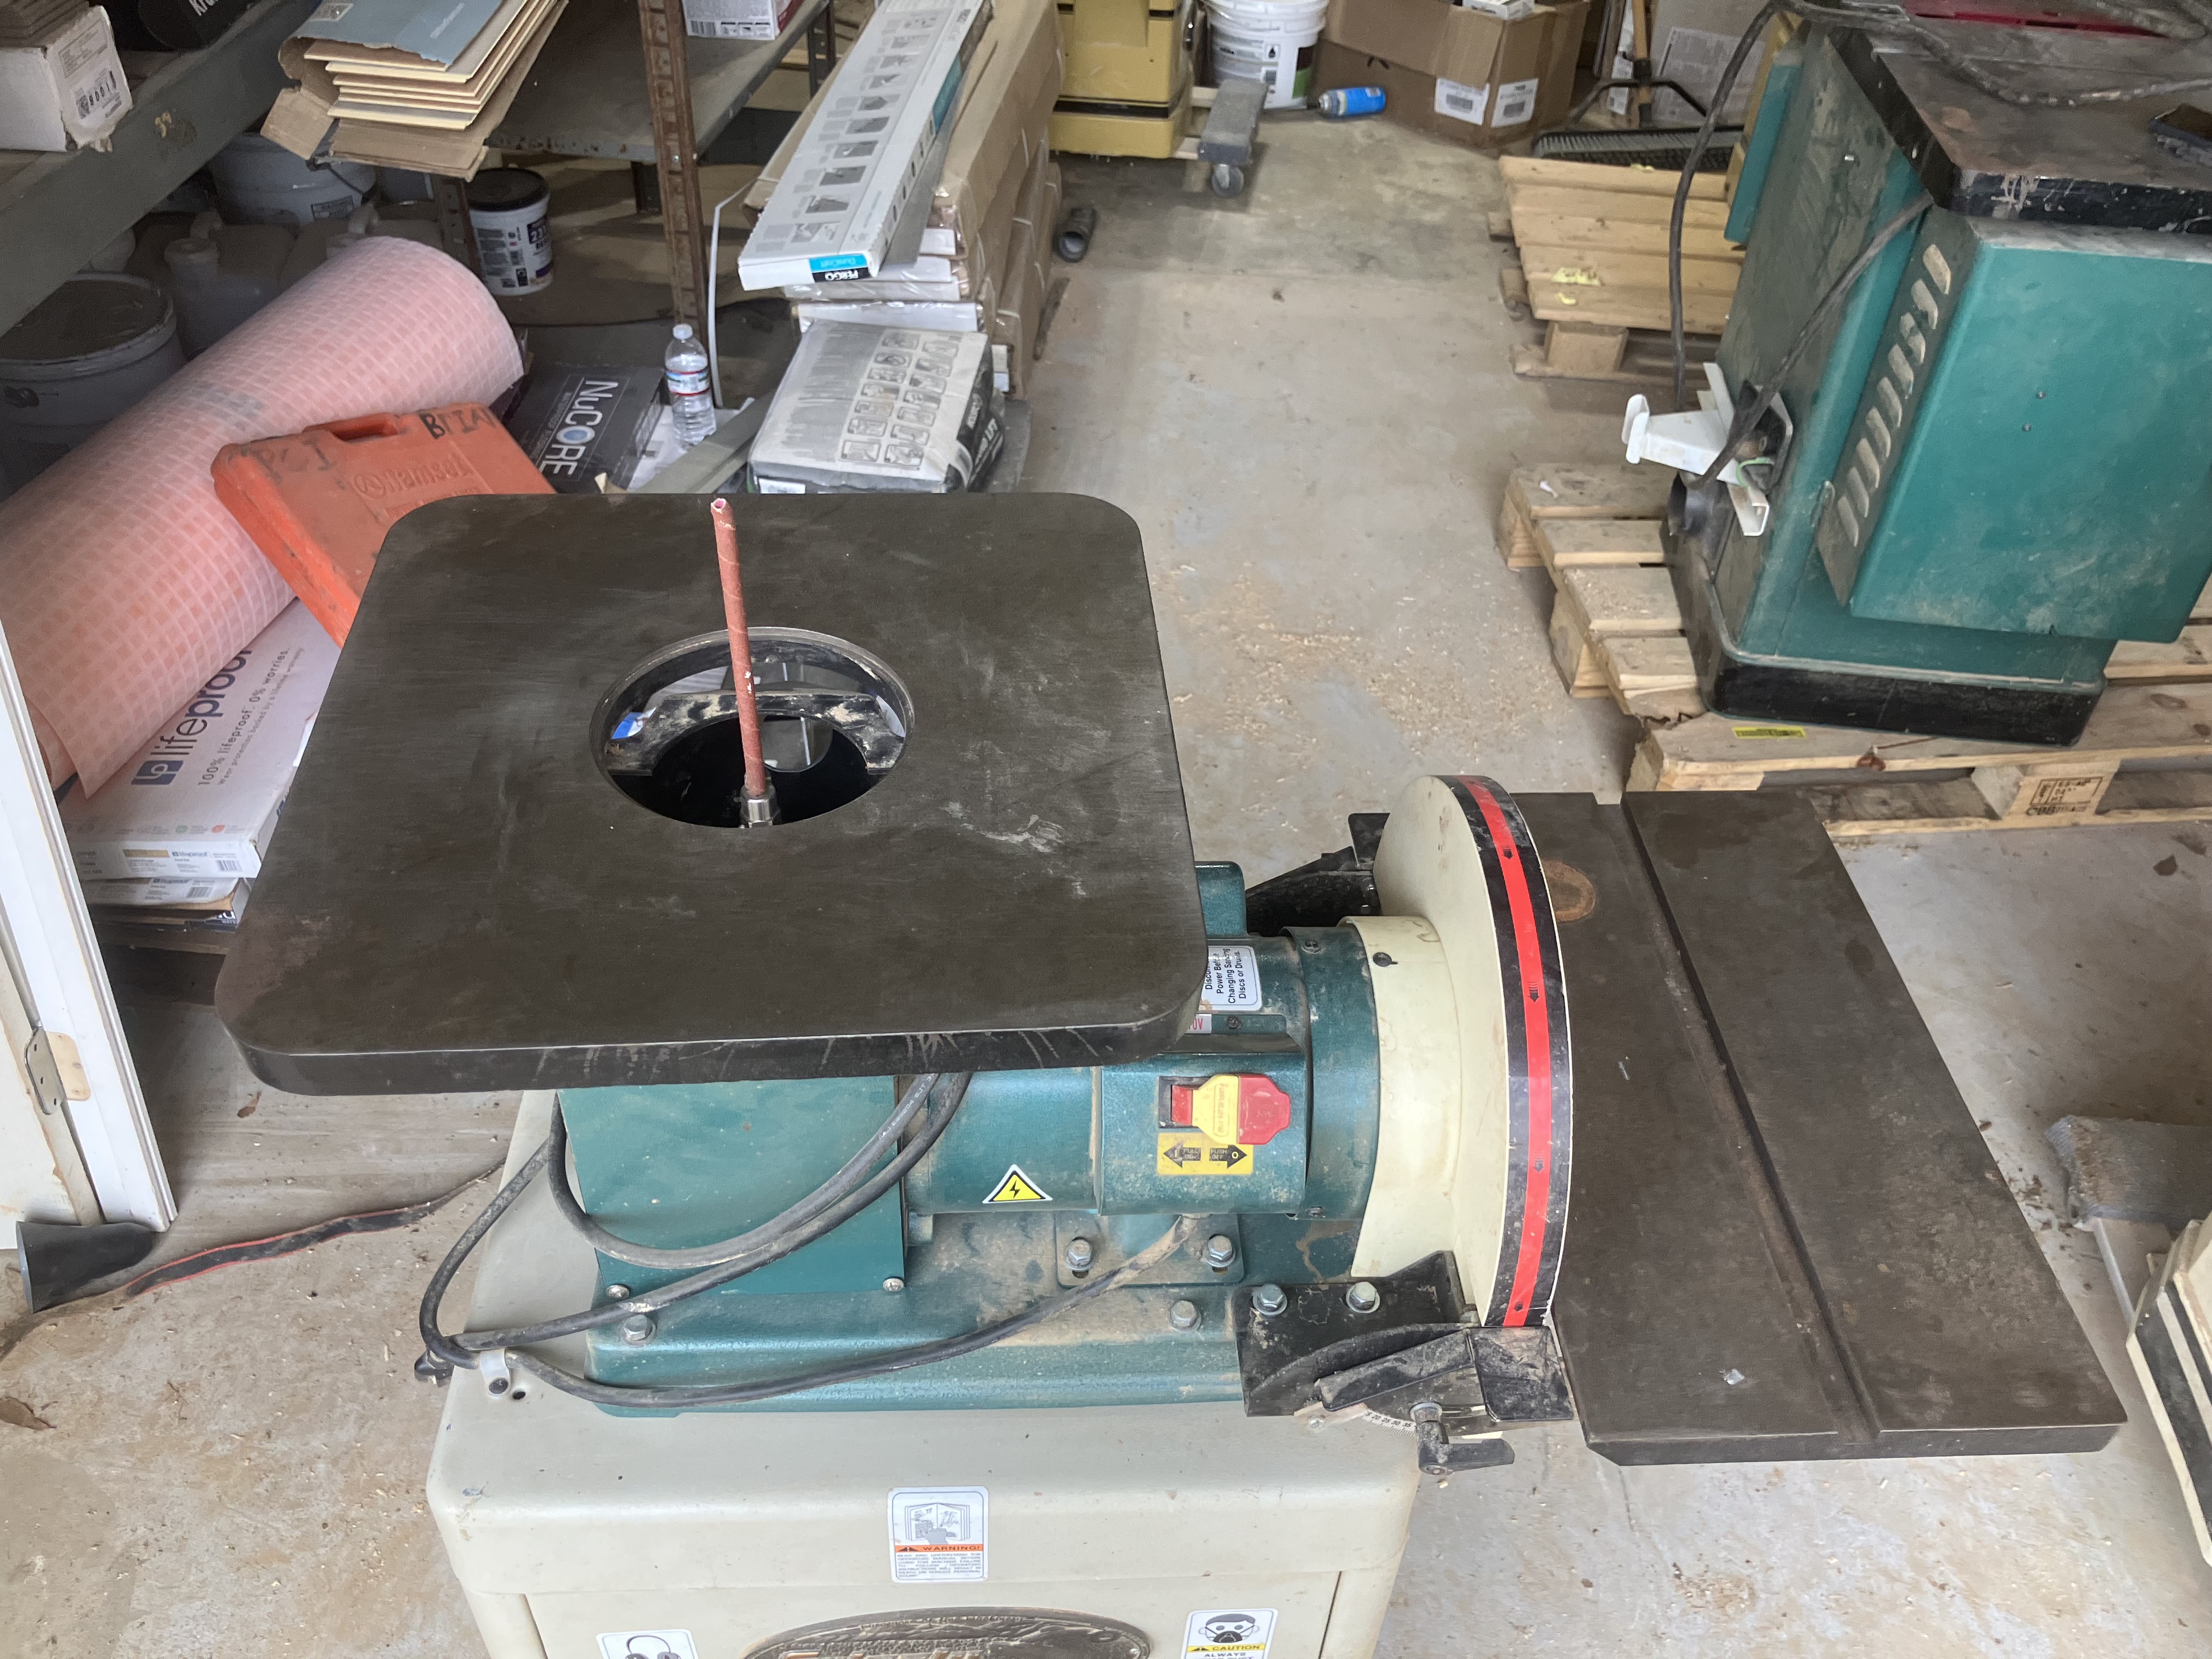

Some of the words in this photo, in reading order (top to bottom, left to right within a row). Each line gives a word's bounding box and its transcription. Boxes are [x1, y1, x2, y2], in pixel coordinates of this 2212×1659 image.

[538, 380, 619, 476] NuCORE
[150, 650, 252, 755] lifeproo
[198, 757, 225, 786] 100%
[249, 688, 266, 703] 0%
[1226, 969, 1236, 1004] Changing
